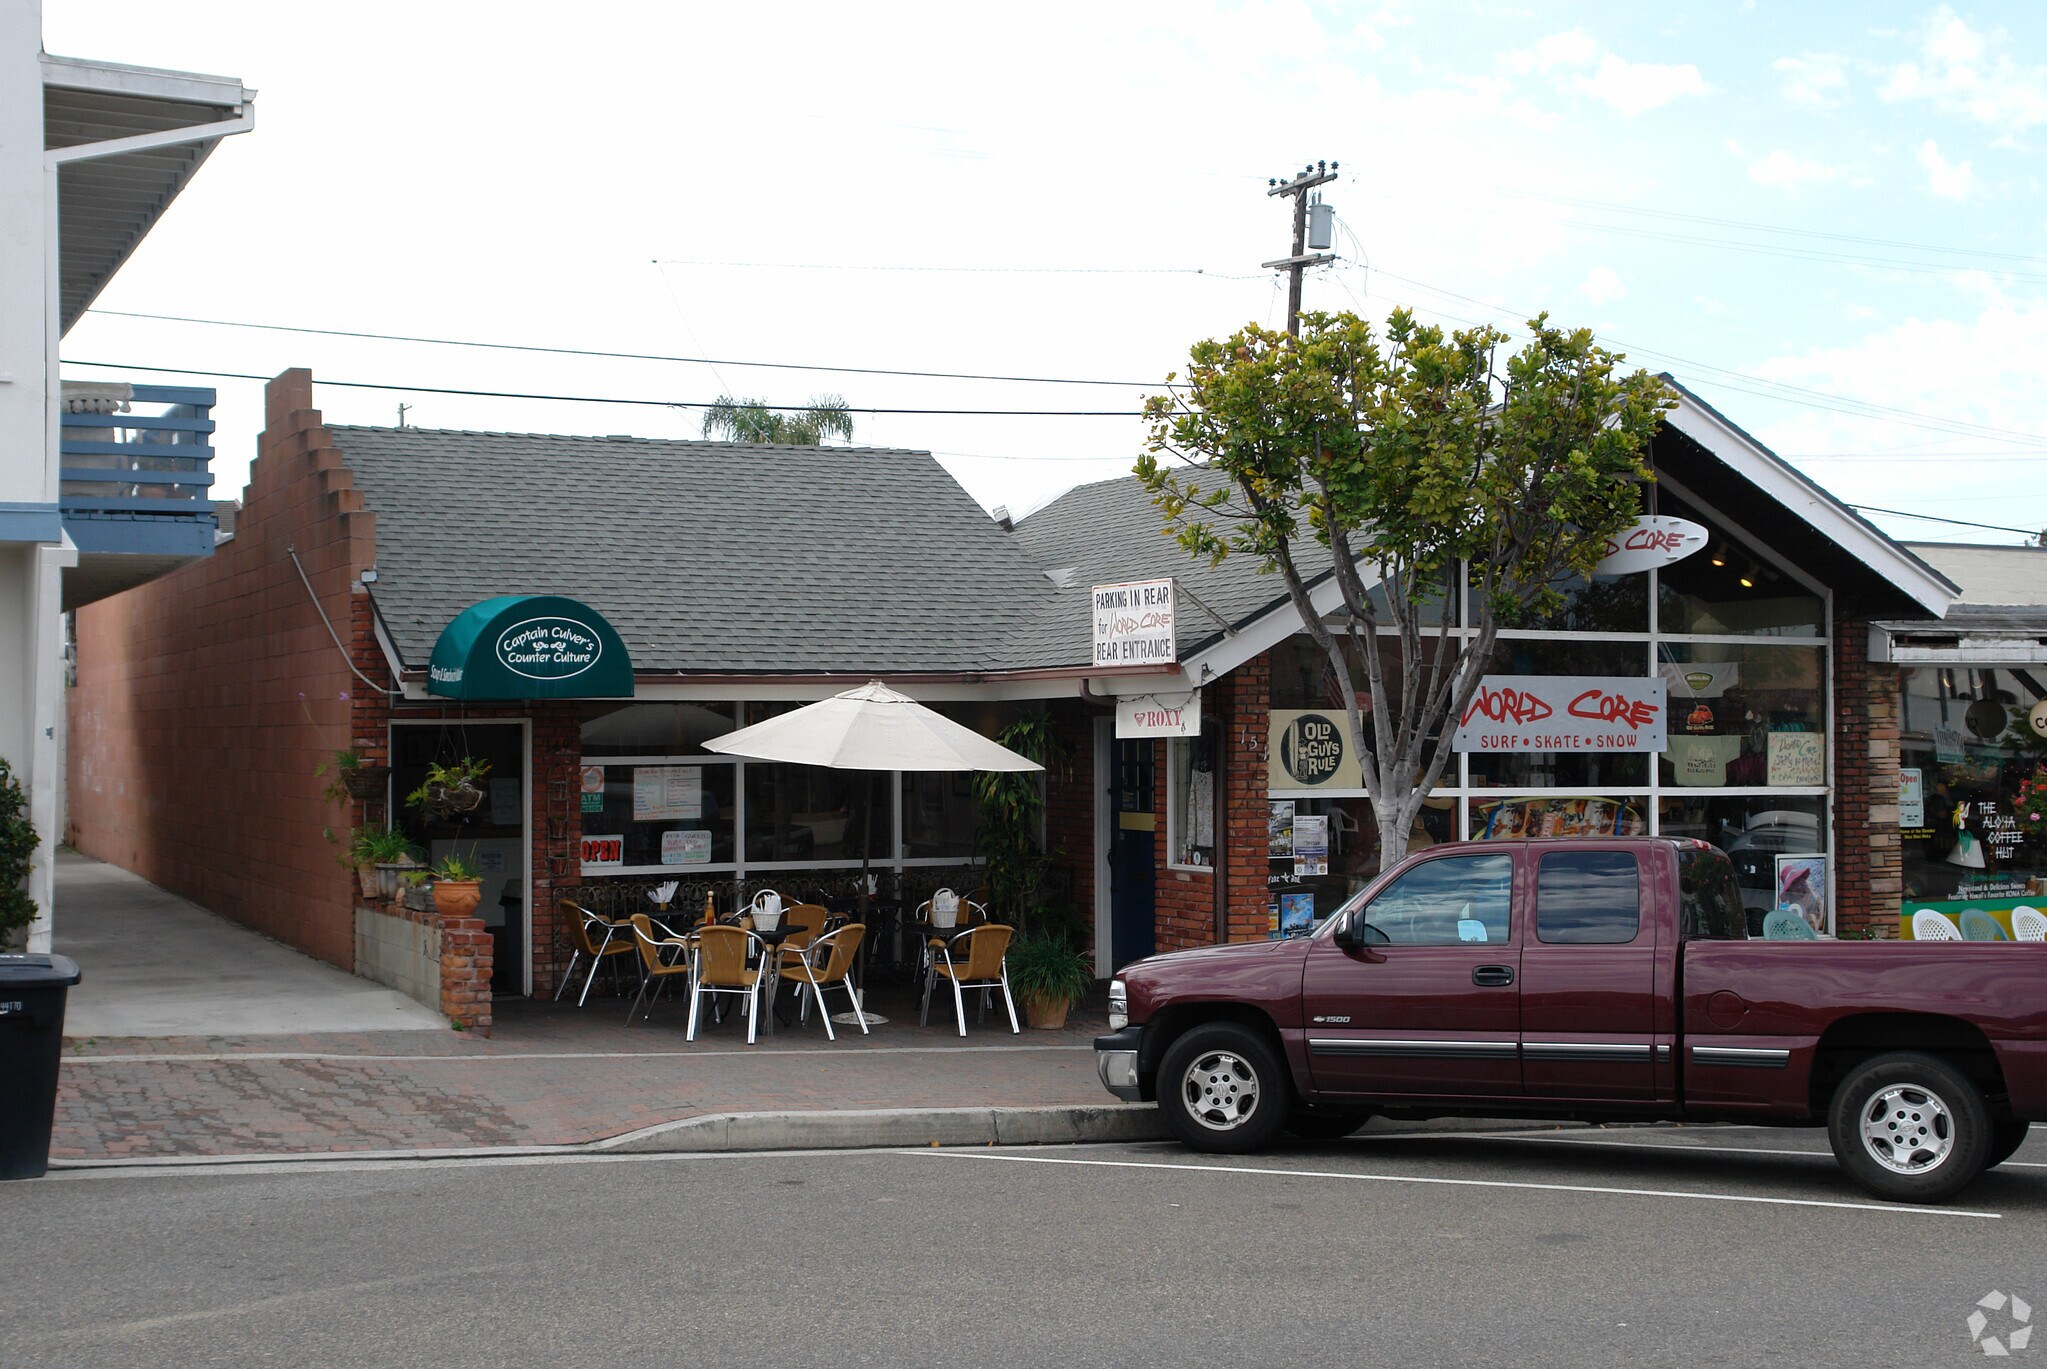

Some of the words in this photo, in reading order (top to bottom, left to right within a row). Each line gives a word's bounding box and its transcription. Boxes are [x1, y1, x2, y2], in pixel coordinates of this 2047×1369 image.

[1625, 529, 1685, 553] CORE
[1096, 591, 1127, 610] PARKING
[1130, 589, 1141, 608] IN
[1144, 586, 1170, 606] REAR
[1098, 617, 1107, 635] for
[1109, 612, 1139, 639] WORLD
[1140, 612, 1171, 629] CORE
[503, 626, 548, 651] Captain
[551, 627, 595, 651] Culver's
[508, 651, 551, 663] Counter
[553, 651, 591, 663] Culture
[1096, 642, 1118, 661] REAR
[1122, 639, 1171, 659] ENTRANCE
[1460, 686, 1553, 728] WORLD
[1567, 689, 1659, 731] CORE
[1146, 709, 1182, 727] ROXY
[1304, 722, 1331, 740] OLD
[1307, 741, 1340, 757] GUYS
[1481, 735, 1518, 748] SURF
[1535, 735, 1581, 748] SKATE
[1597, 734, 1638, 748] SNOW
[1308, 756, 1336, 775] RULE
[1900, 773, 1918, 786] Open
[581, 794, 601, 802] ATM
[1978, 801, 1997, 814] THE
[1983, 815, 2016, 829] ALOHA
[1988, 831, 2024, 844] COFFEE
[581, 840, 622, 863] OPEN
[1995, 846, 2015, 859] HUT
